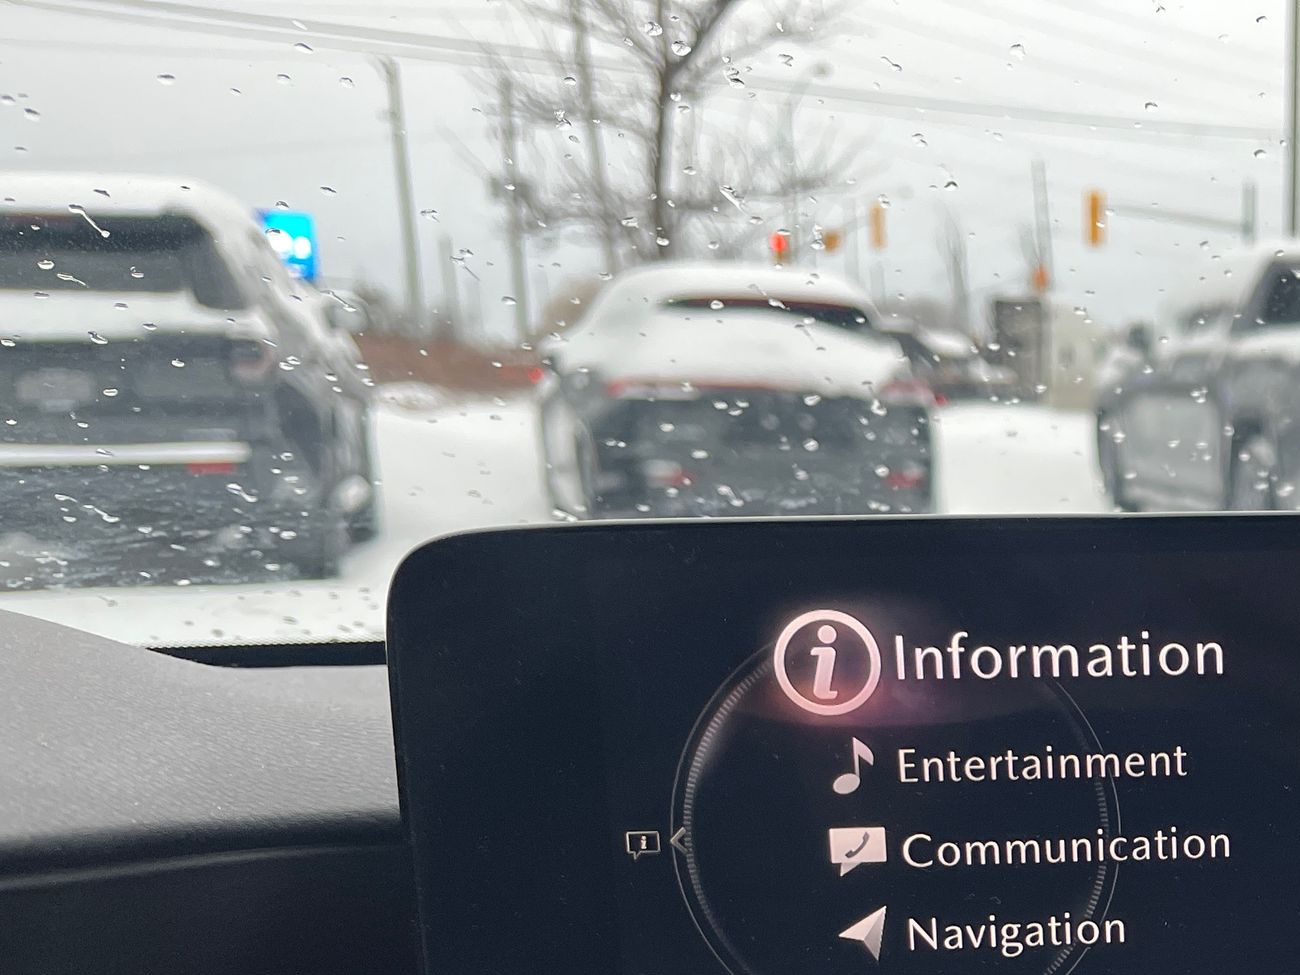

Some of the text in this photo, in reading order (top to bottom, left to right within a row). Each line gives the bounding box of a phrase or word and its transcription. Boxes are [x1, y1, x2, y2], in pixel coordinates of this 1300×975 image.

[894, 630, 1224, 681] Information
[898, 745, 1188, 783] Entertainment
[902, 828, 1231, 867] Communication
[908, 911, 1126, 958] Navigation
